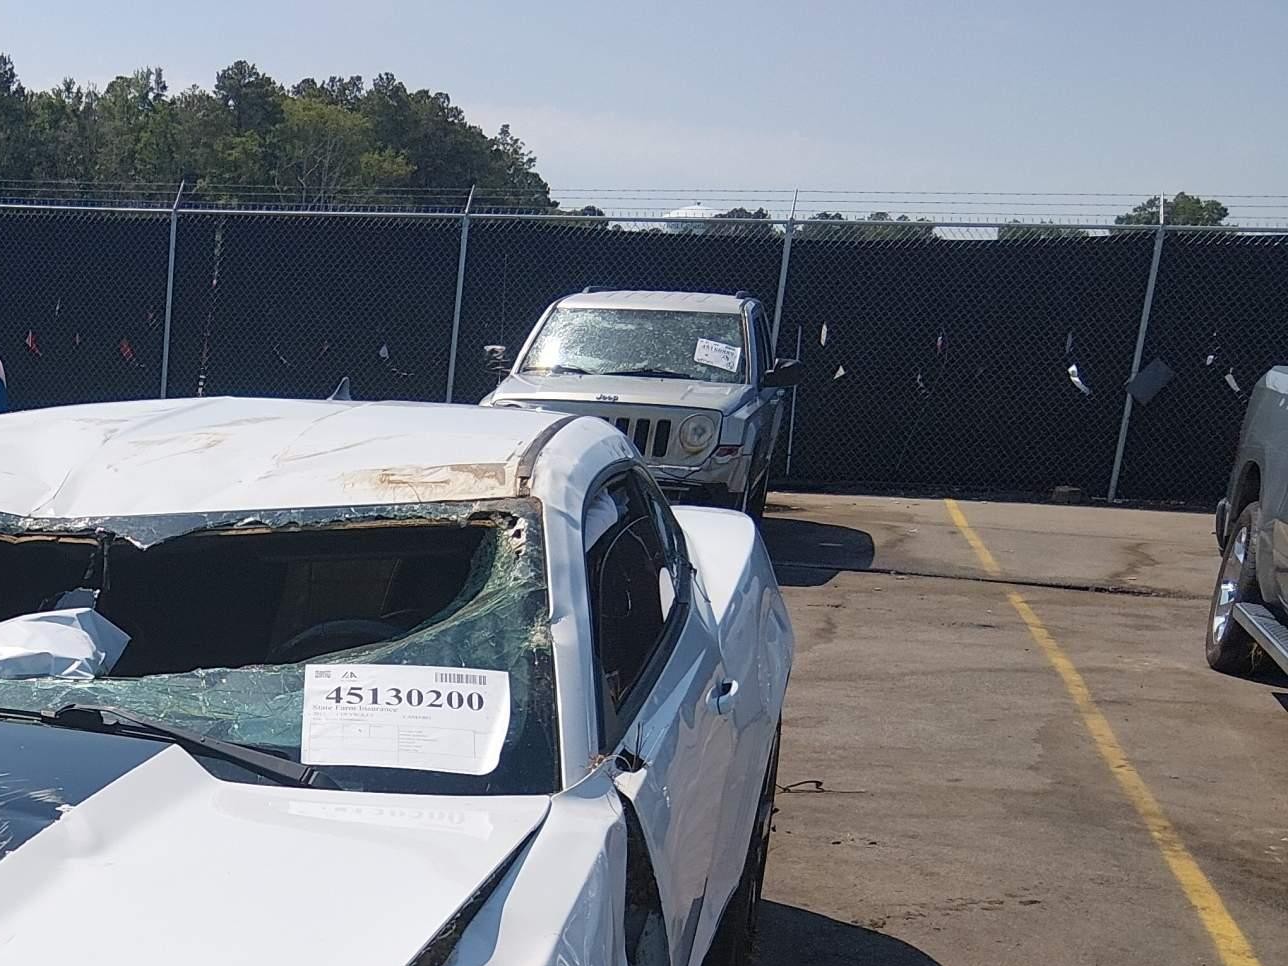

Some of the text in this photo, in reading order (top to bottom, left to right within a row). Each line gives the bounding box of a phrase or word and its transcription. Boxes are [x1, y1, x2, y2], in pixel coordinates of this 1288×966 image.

[596, 394, 619, 403] Jeep
[325, 686, 485, 711] 45130200
[335, 704, 357, 712] Farm
